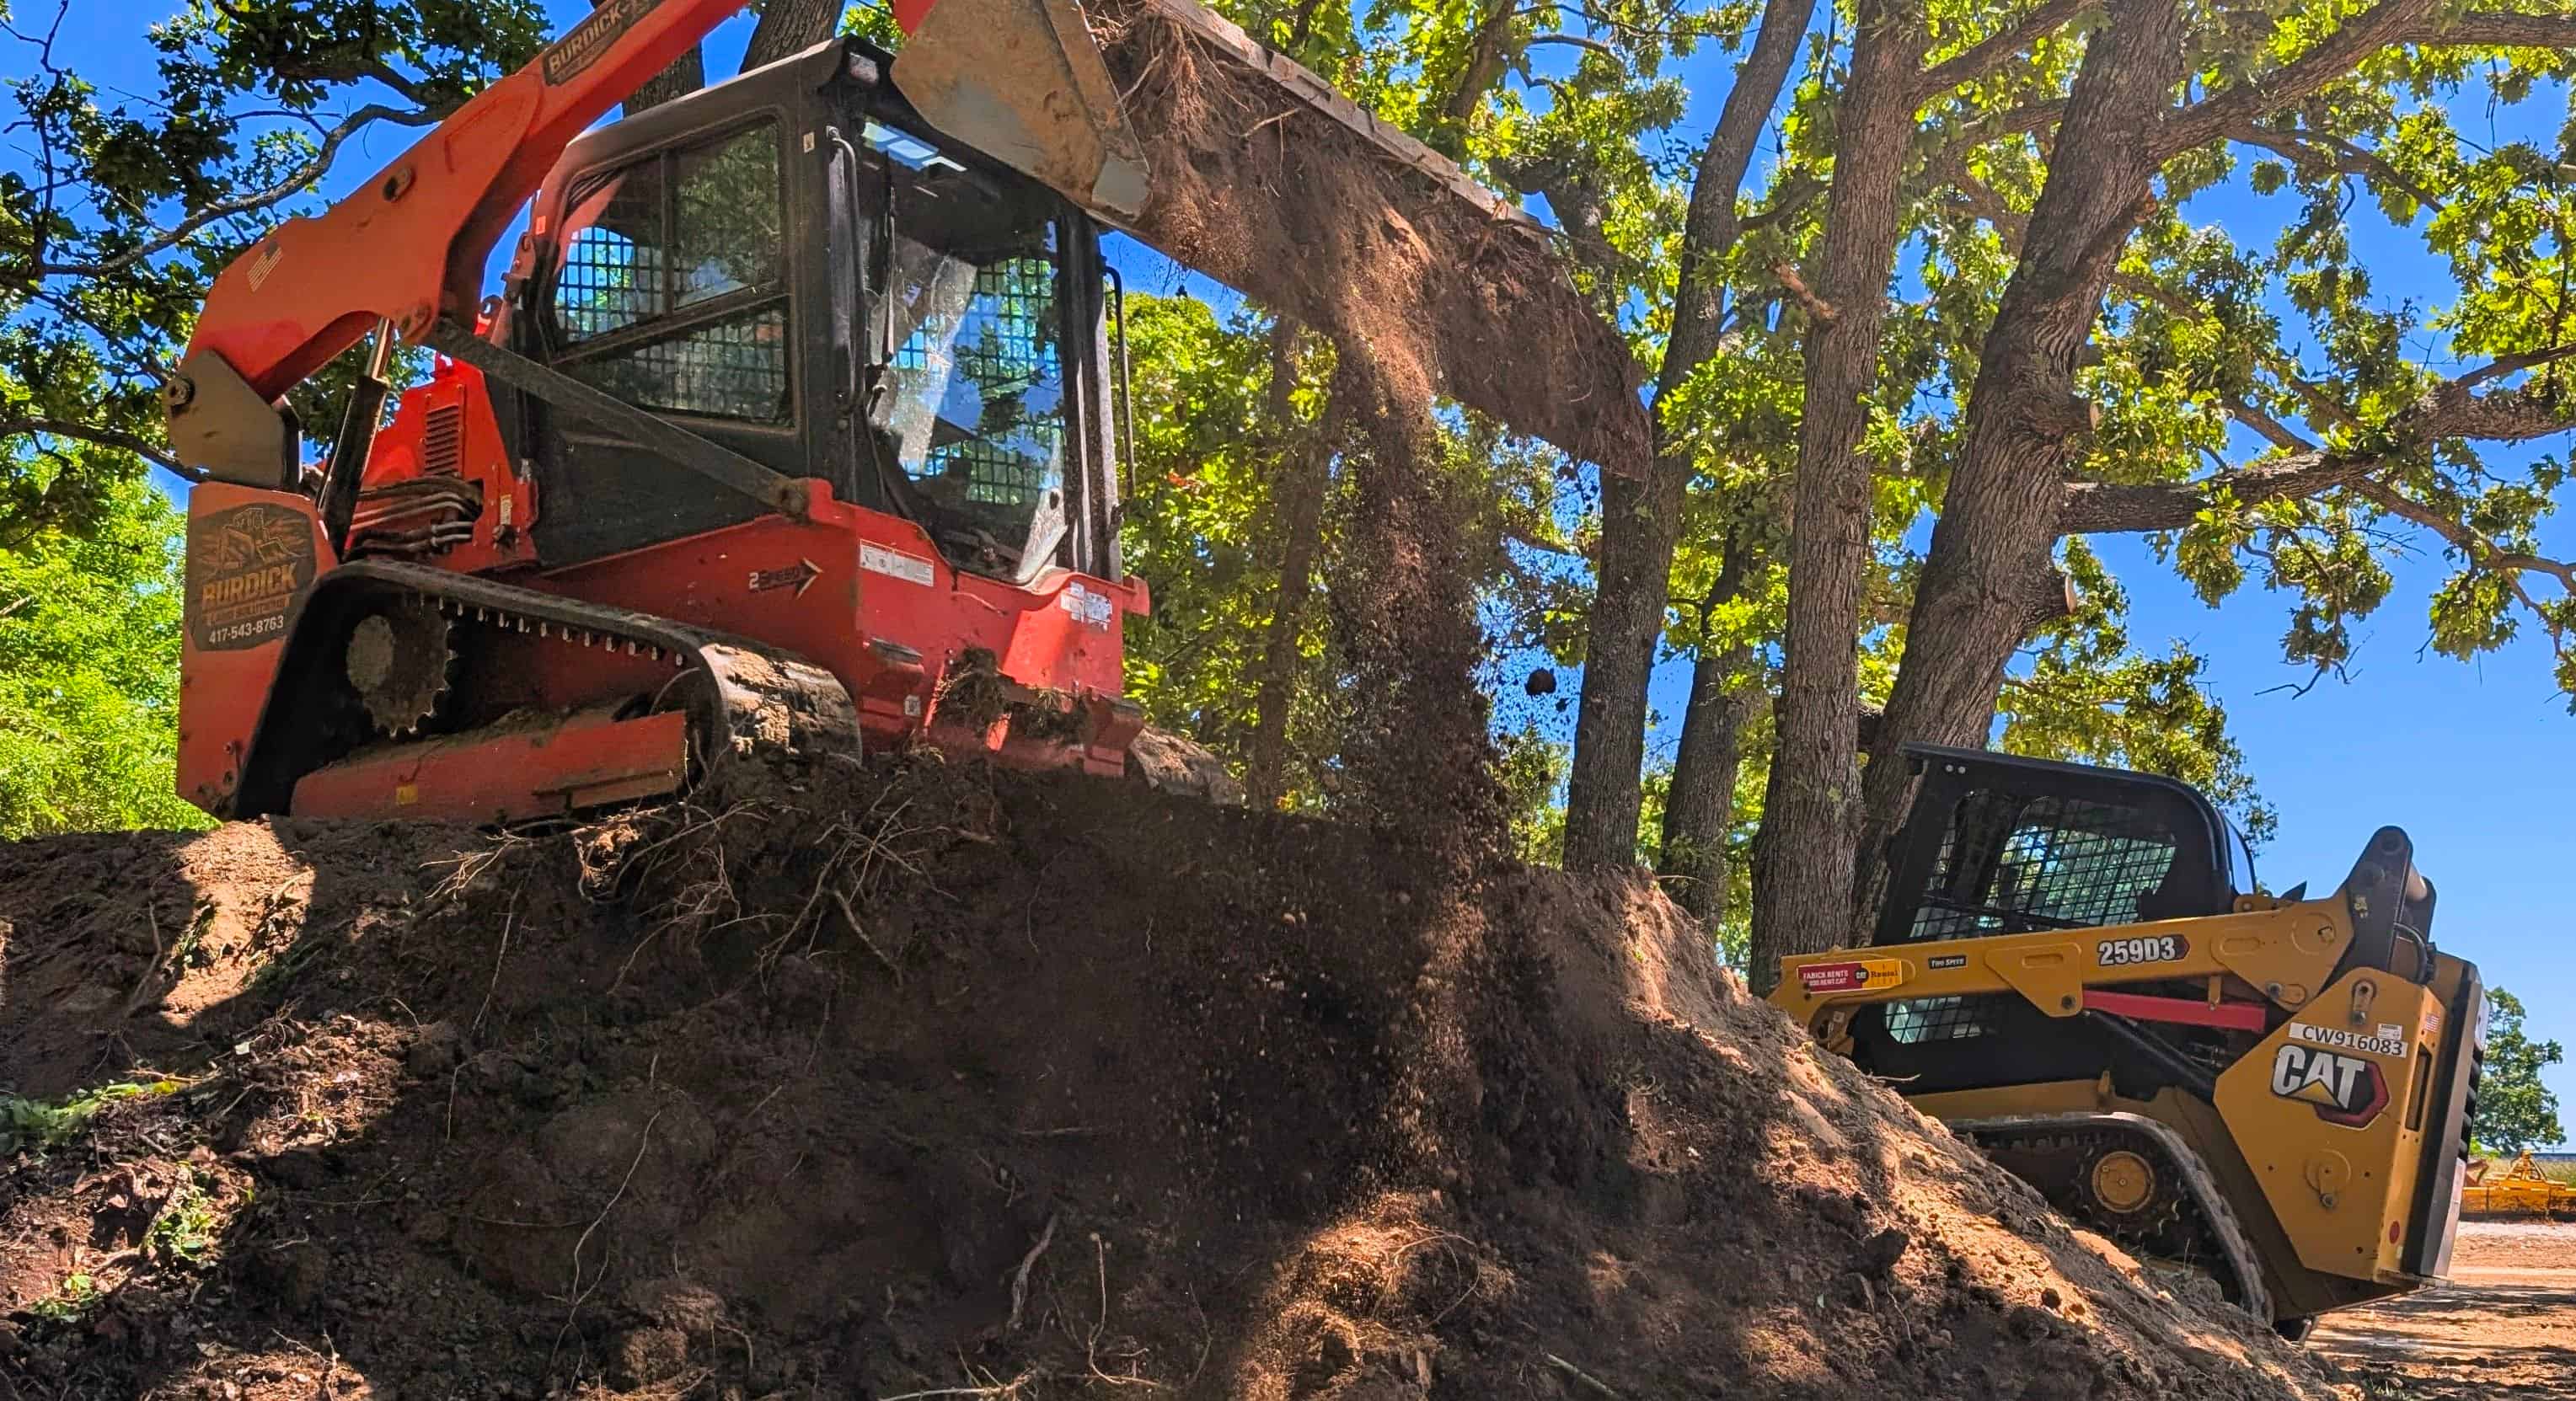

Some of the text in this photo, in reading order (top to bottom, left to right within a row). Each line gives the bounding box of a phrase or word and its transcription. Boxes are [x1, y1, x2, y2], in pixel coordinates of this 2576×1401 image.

[549, 2, 622, 74] BURDICK
[202, 562, 297, 604] BURDICK
[209, 615, 284, 644] 417-543-8763
[2098, 937, 2176, 965] 259D3
[2302, 1025, 2402, 1056] CW916083
[2272, 1045, 2366, 1110] CAT
